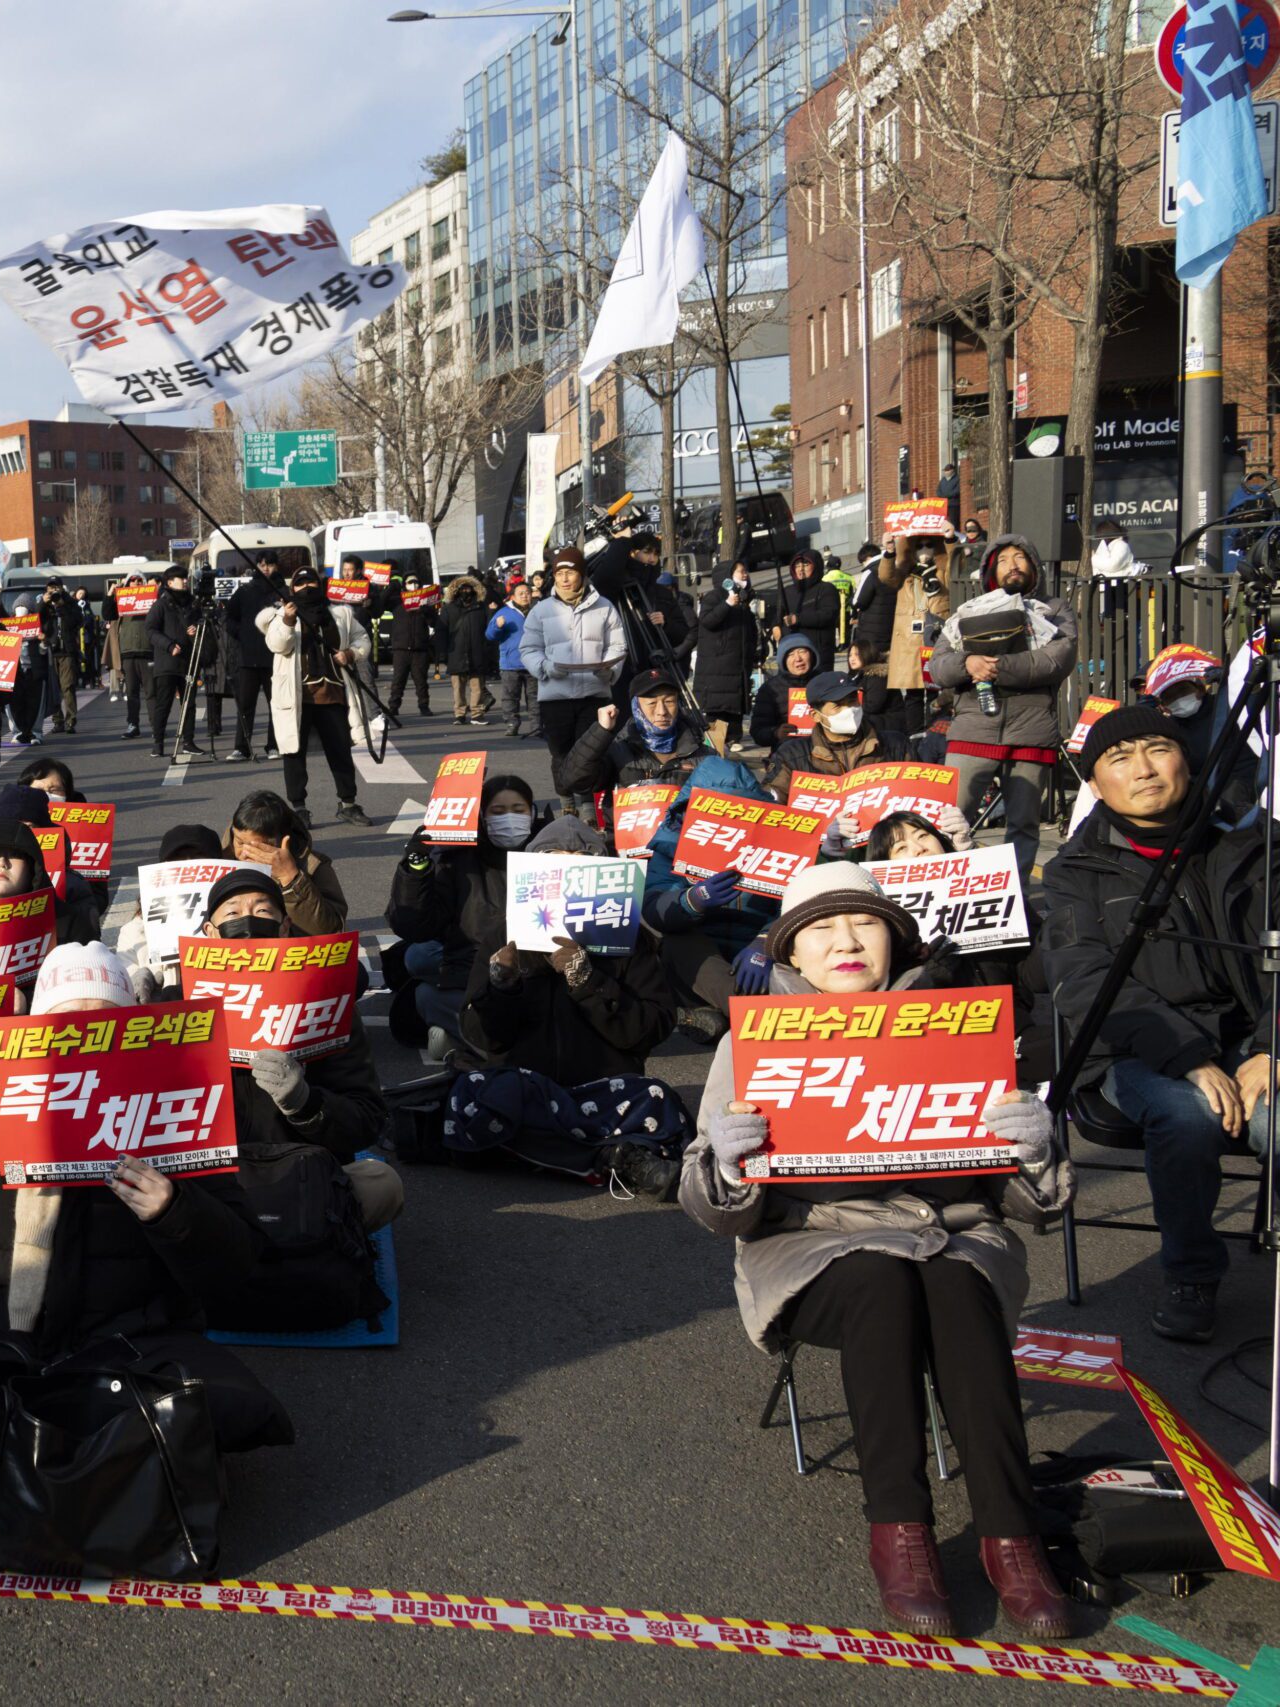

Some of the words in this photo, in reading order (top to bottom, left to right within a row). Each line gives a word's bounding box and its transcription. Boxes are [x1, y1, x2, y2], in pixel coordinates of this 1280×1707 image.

[20, 222, 161, 297] 굴욕외교
[70, 258, 229, 351] 윤석열
[225, 217, 337, 278] 탄핵
[115, 346, 249, 405] 검찰독재
[1095, 421, 1116, 437] olf
[1124, 418, 1180, 435] Made
[1113, 440, 1131, 449] LAB
[642, 505, 660, 522] 울
[909, 514, 945, 528] 체포!
[1093, 501, 1137, 517] ENDS
[632, 523, 660, 536] SEOU
[1120, 518, 1162, 527] HANNAM
[442, 758, 481, 776] 윤석열
[842, 766, 902, 792] 내란수괴
[901, 766, 954, 785] 윤석열
[616, 789, 670, 807] 내란수괴
[791, 794, 841, 819] 즉각
[842, 786, 890, 815] 즉각
[66, 808, 111, 824] 윤석열
[617, 808, 661, 832] 즉각
[691, 794, 764, 824] 내란수괴
[762, 809, 820, 834] 윤석열
[684, 818, 746, 853] 즉각
[725, 845, 811, 882] 체포!
[515, 868, 562, 886] 내란수괴
[565, 862, 636, 898] 체포!
[872, 858, 970, 886] 특급범죄자
[948, 871, 1011, 898] 김건희
[516, 882, 561, 903] 윤석열
[147, 892, 202, 924] 즉각
[564, 897, 632, 933] 구속!
[929, 894, 1016, 937] 체포!
[183, 945, 278, 972] 내란수괴
[280, 940, 353, 972] 윤석열
[120, 1009, 216, 1050] 윤석열
[250, 994, 350, 1047] 체포!
[737, 1003, 888, 1041] 내란수괴
[889, 997, 1003, 1038] 윤석열
[744, 1056, 866, 1109] 즉각
[845, 1079, 1008, 1143] 체포!
[86, 1083, 225, 1151] 체포!
[32, 1164, 52, 1172] 윤석열
[55, 1163, 69, 1172] 즉각
[71, 1163, 89, 1171] 체포!
[160, 1154, 183, 1165] 때까지
[184, 1151, 210, 1163] 모이자!
[777, 1156, 802, 1165] 윤석열
[806, 1156, 822, 1165] 즉각
[826, 1155, 845, 1164] 체포!
[849, 1155, 874, 1164] 김건희
[877, 1155, 894, 1163] 즉각
[897, 1153, 917, 1161] 구속!
[920, 1153, 927, 1161] 될
[930, 1151, 955, 1159] 때까지
[958, 1150, 986, 1158] 모이자!
[1177, 1454, 1271, 1575] 내란수괴
[109, 1577, 205, 1601] 안전제일
[216, 1584, 270, 1607] 危險
[283, 1590, 332, 1611] 위험
[391, 1599, 500, 1624] DANGER!
[527, 1609, 632, 1636] 안전제일
[645, 1618, 704, 1642] 危險
[717, 1623, 772, 1647] 위험
[834, 1636, 956, 1665] DANGER!
[988, 1650, 1101, 1677] 안전제일
[1117, 1662, 1181, 1685] 危險
[1198, 1669, 1238, 1690] 험
